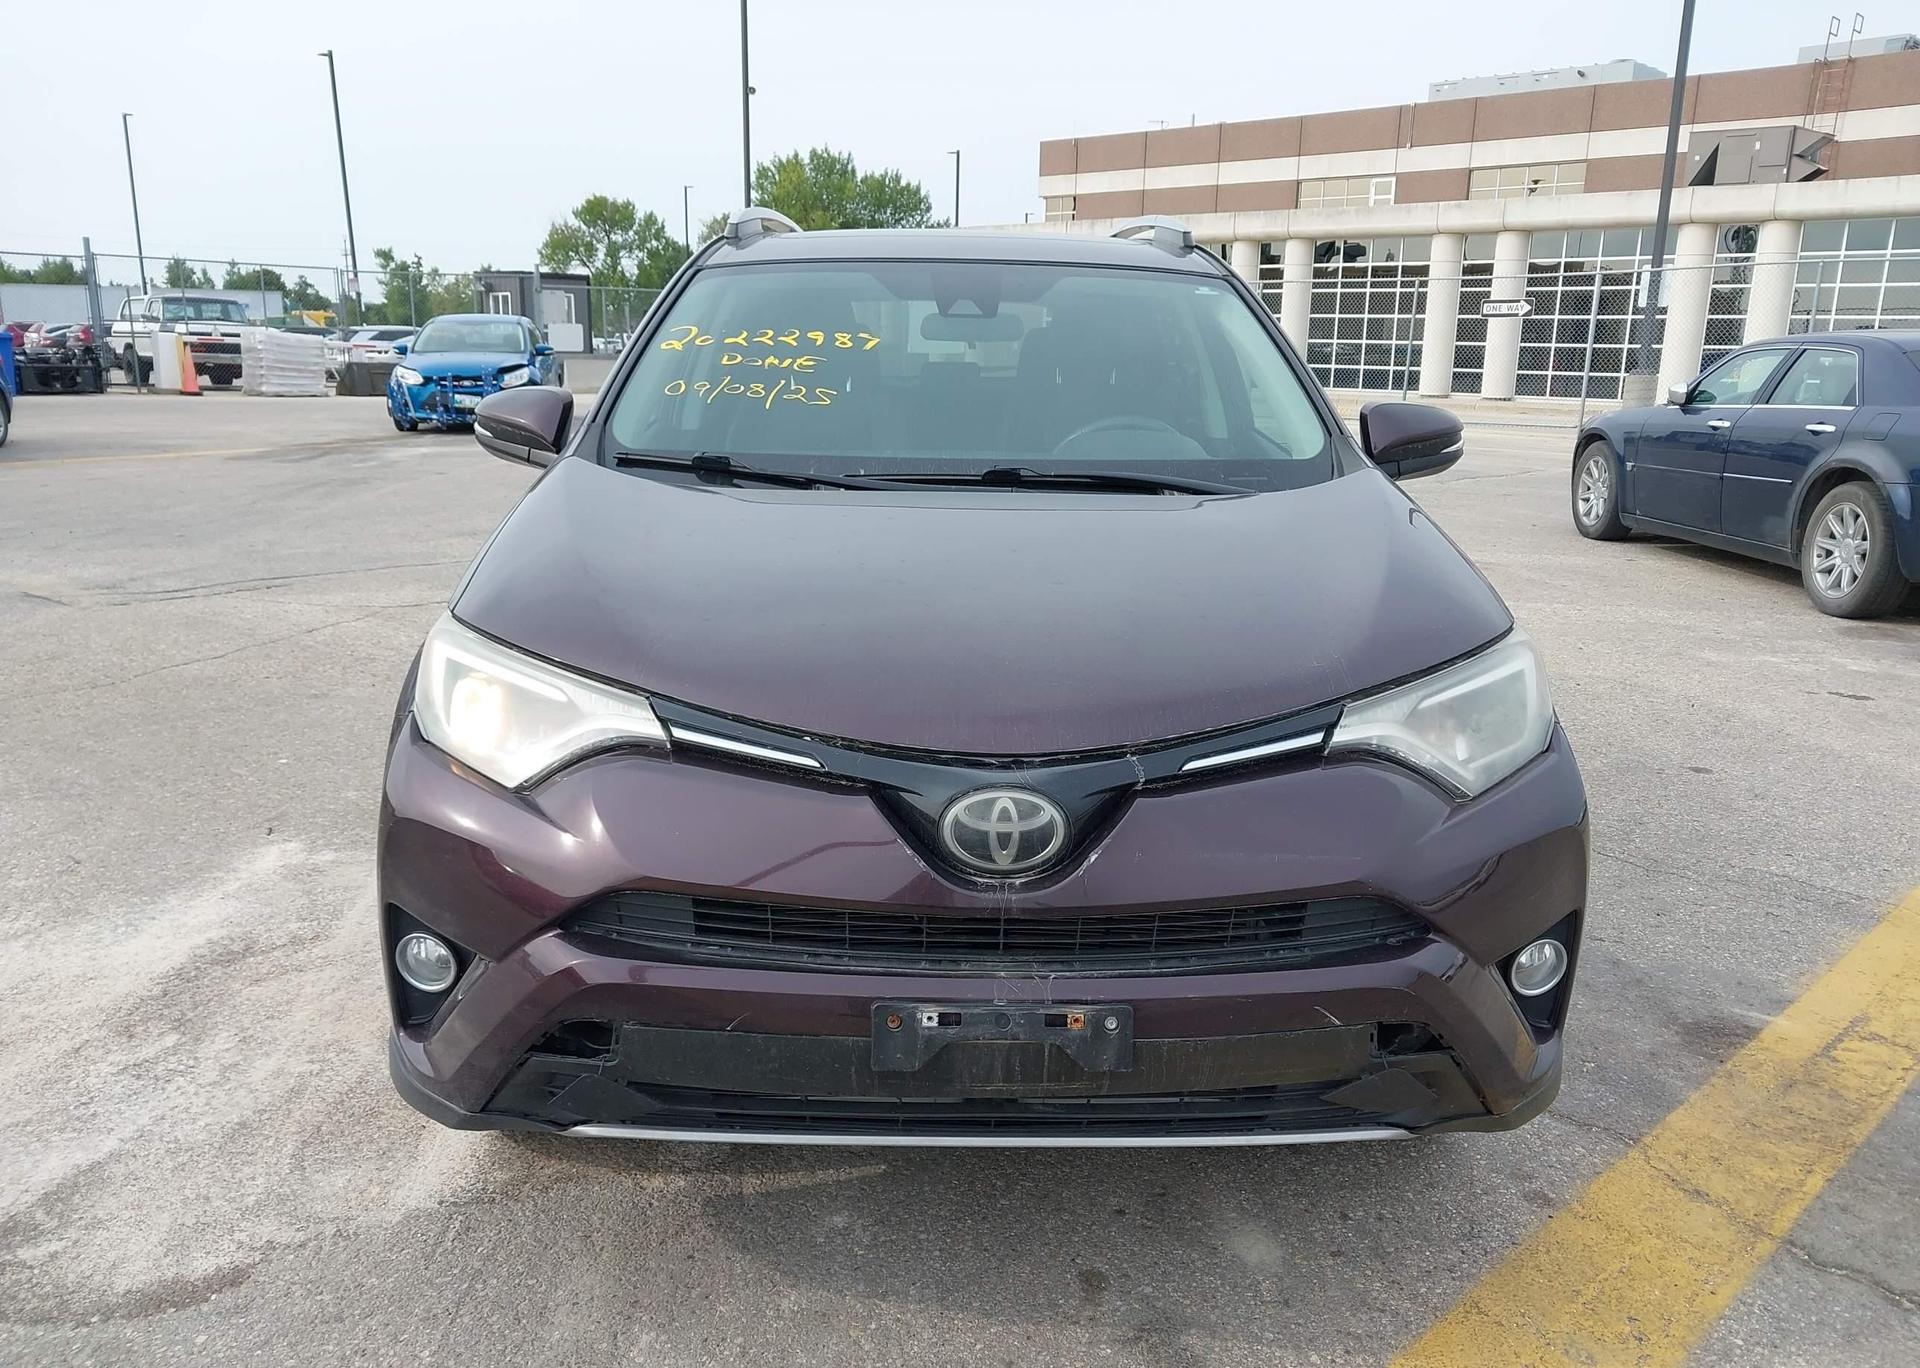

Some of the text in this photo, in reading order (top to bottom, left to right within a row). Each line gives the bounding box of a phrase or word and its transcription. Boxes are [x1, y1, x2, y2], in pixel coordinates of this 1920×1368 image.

[1485, 304, 1525, 313] ONE WAY
[664, 375, 838, 409] 09/08/25
